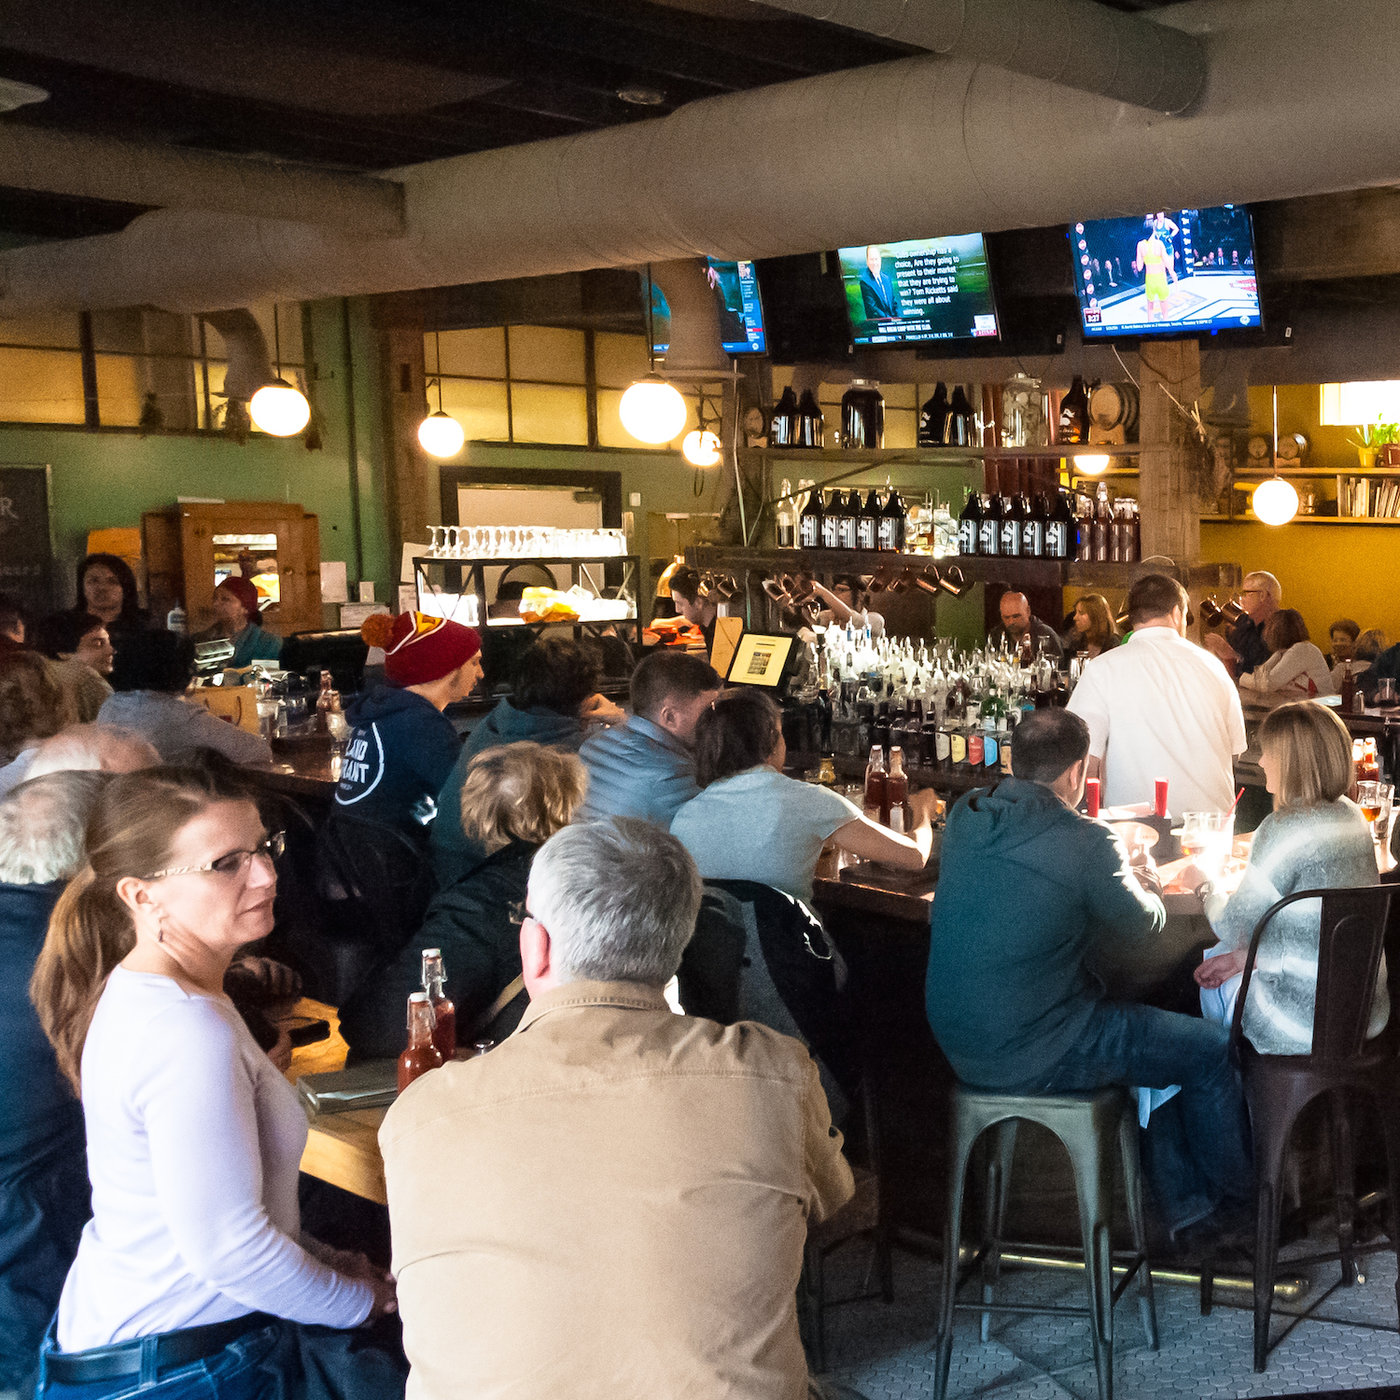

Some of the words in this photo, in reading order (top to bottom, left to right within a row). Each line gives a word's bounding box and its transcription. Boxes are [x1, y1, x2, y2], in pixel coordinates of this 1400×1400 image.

[924, 258, 936, 266] they
[937, 256, 953, 265] going
[953, 255, 960, 263] to
[896, 269, 916, 279] present
[916, 268, 923, 276] to
[923, 267, 936, 275] their
[937, 265, 957, 273] market
[898, 279, 909, 287] that
[909, 278, 922, 287] they
[932, 276, 949, 285] trying
[949, 275, 956, 283] to
[899, 288, 911, 296] win?
[912, 287, 924, 295] Tom
[925, 286, 947, 295] Ricketts
[947, 284, 959, 293] said
[901, 298, 913, 307] they
[935, 295, 951, 304] about
